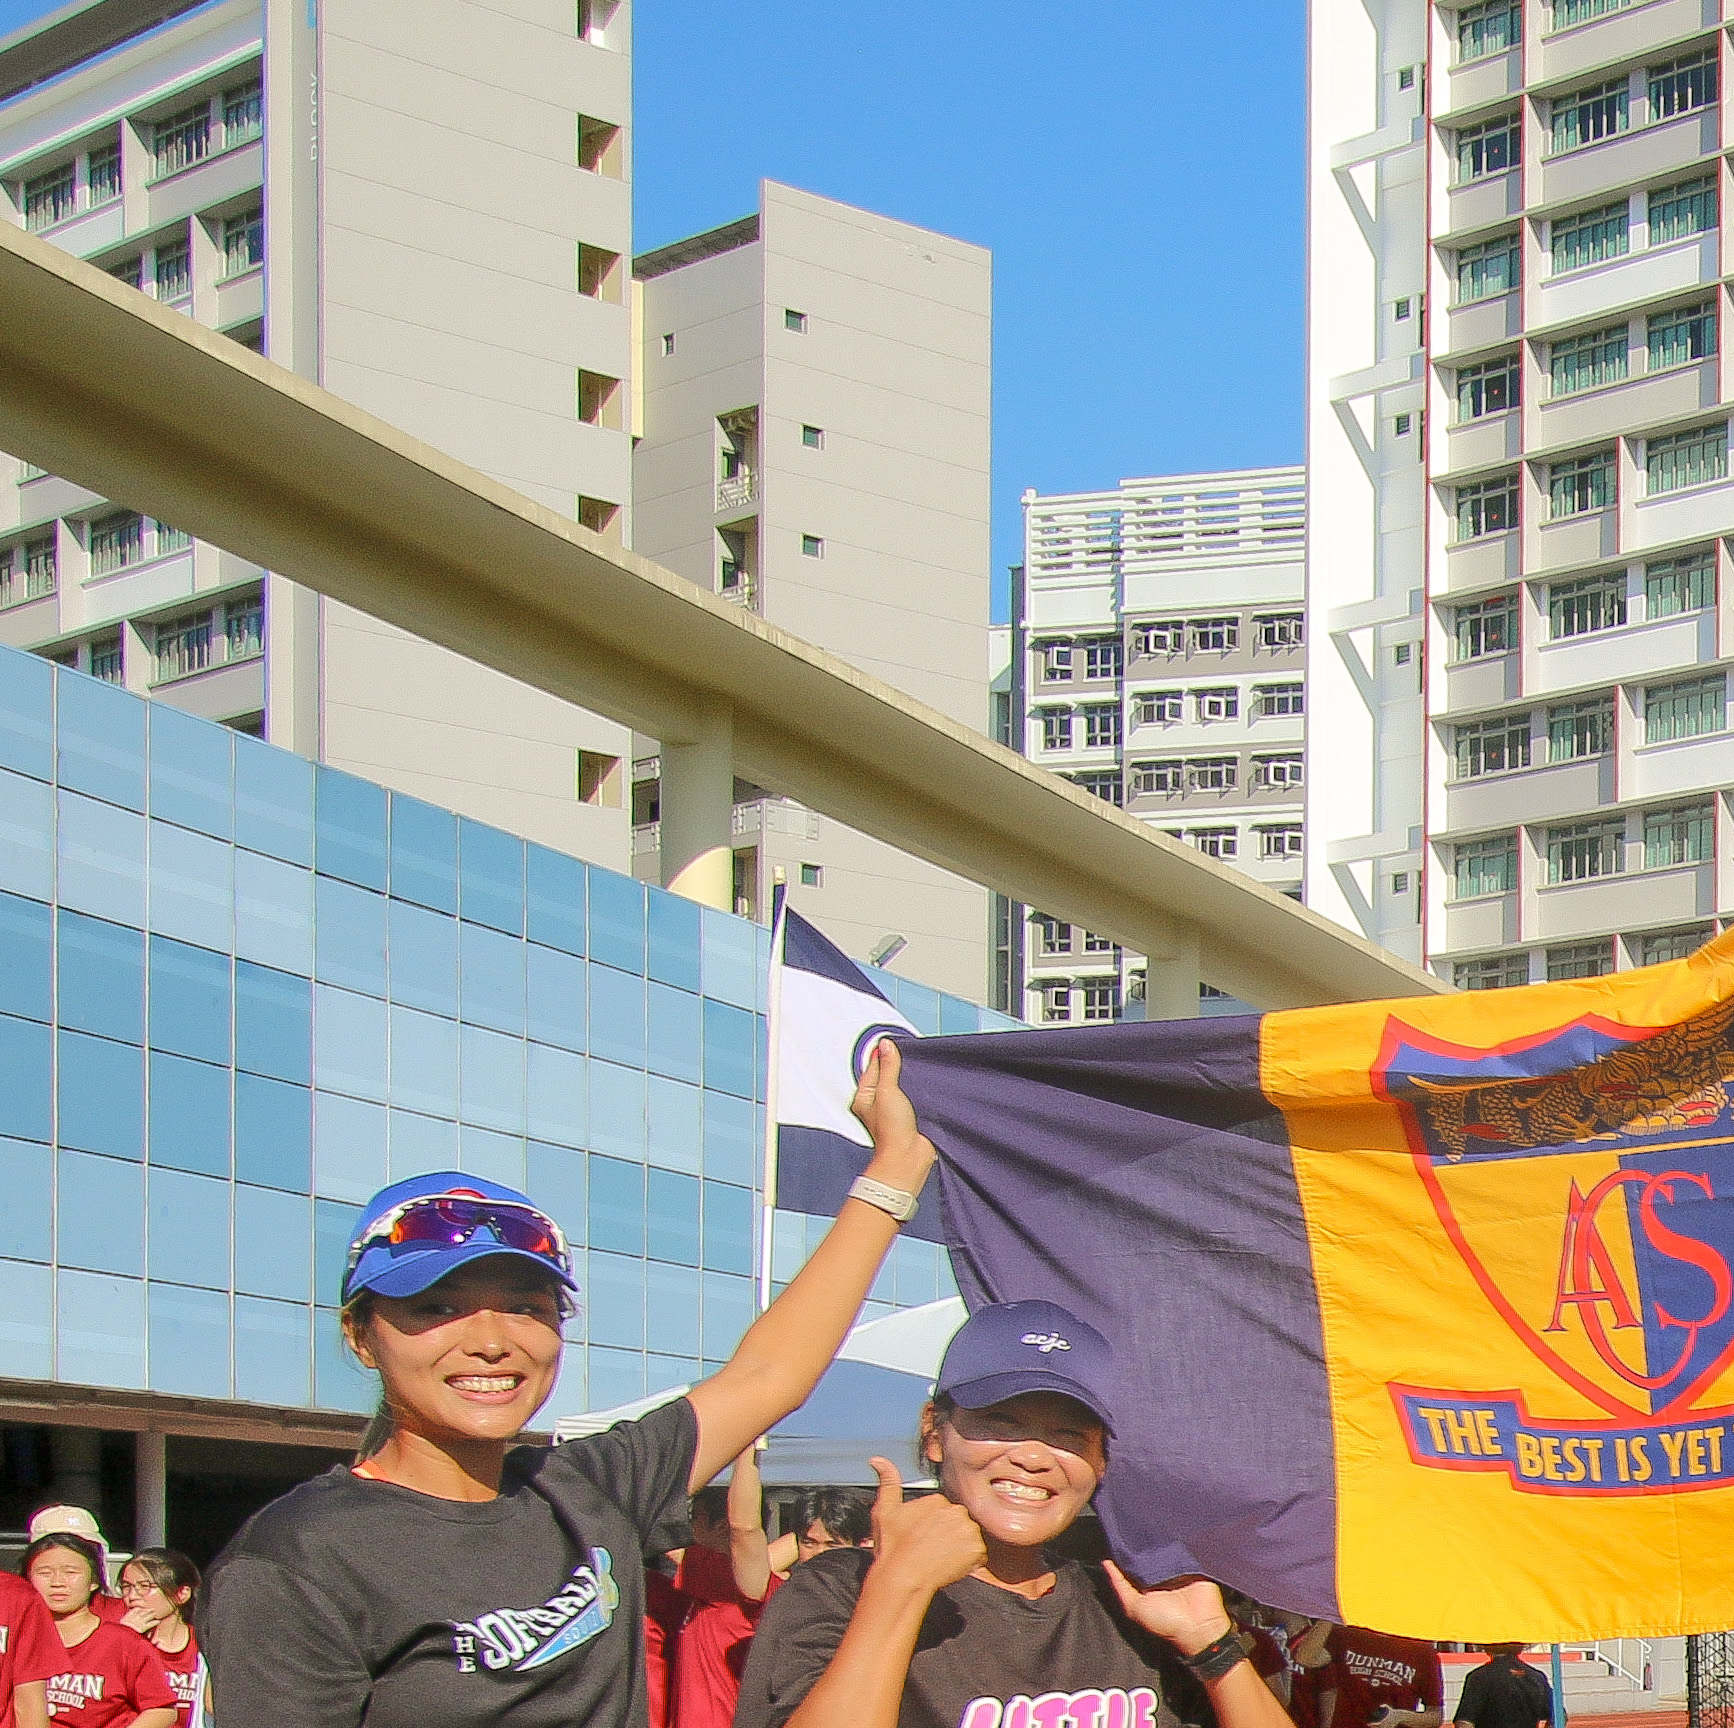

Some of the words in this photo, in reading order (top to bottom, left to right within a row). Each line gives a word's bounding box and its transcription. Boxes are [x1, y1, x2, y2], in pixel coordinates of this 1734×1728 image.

[1418, 1406, 1503, 1455] THE
[1515, 1432, 1603, 1482] BEST
[1614, 1437, 1652, 1482] IS
[1658, 1427, 1726, 1477] YET
[1346, 1651, 1416, 1684] DUNMAN
[1375, 1668, 1404, 1686] SCHOOL
